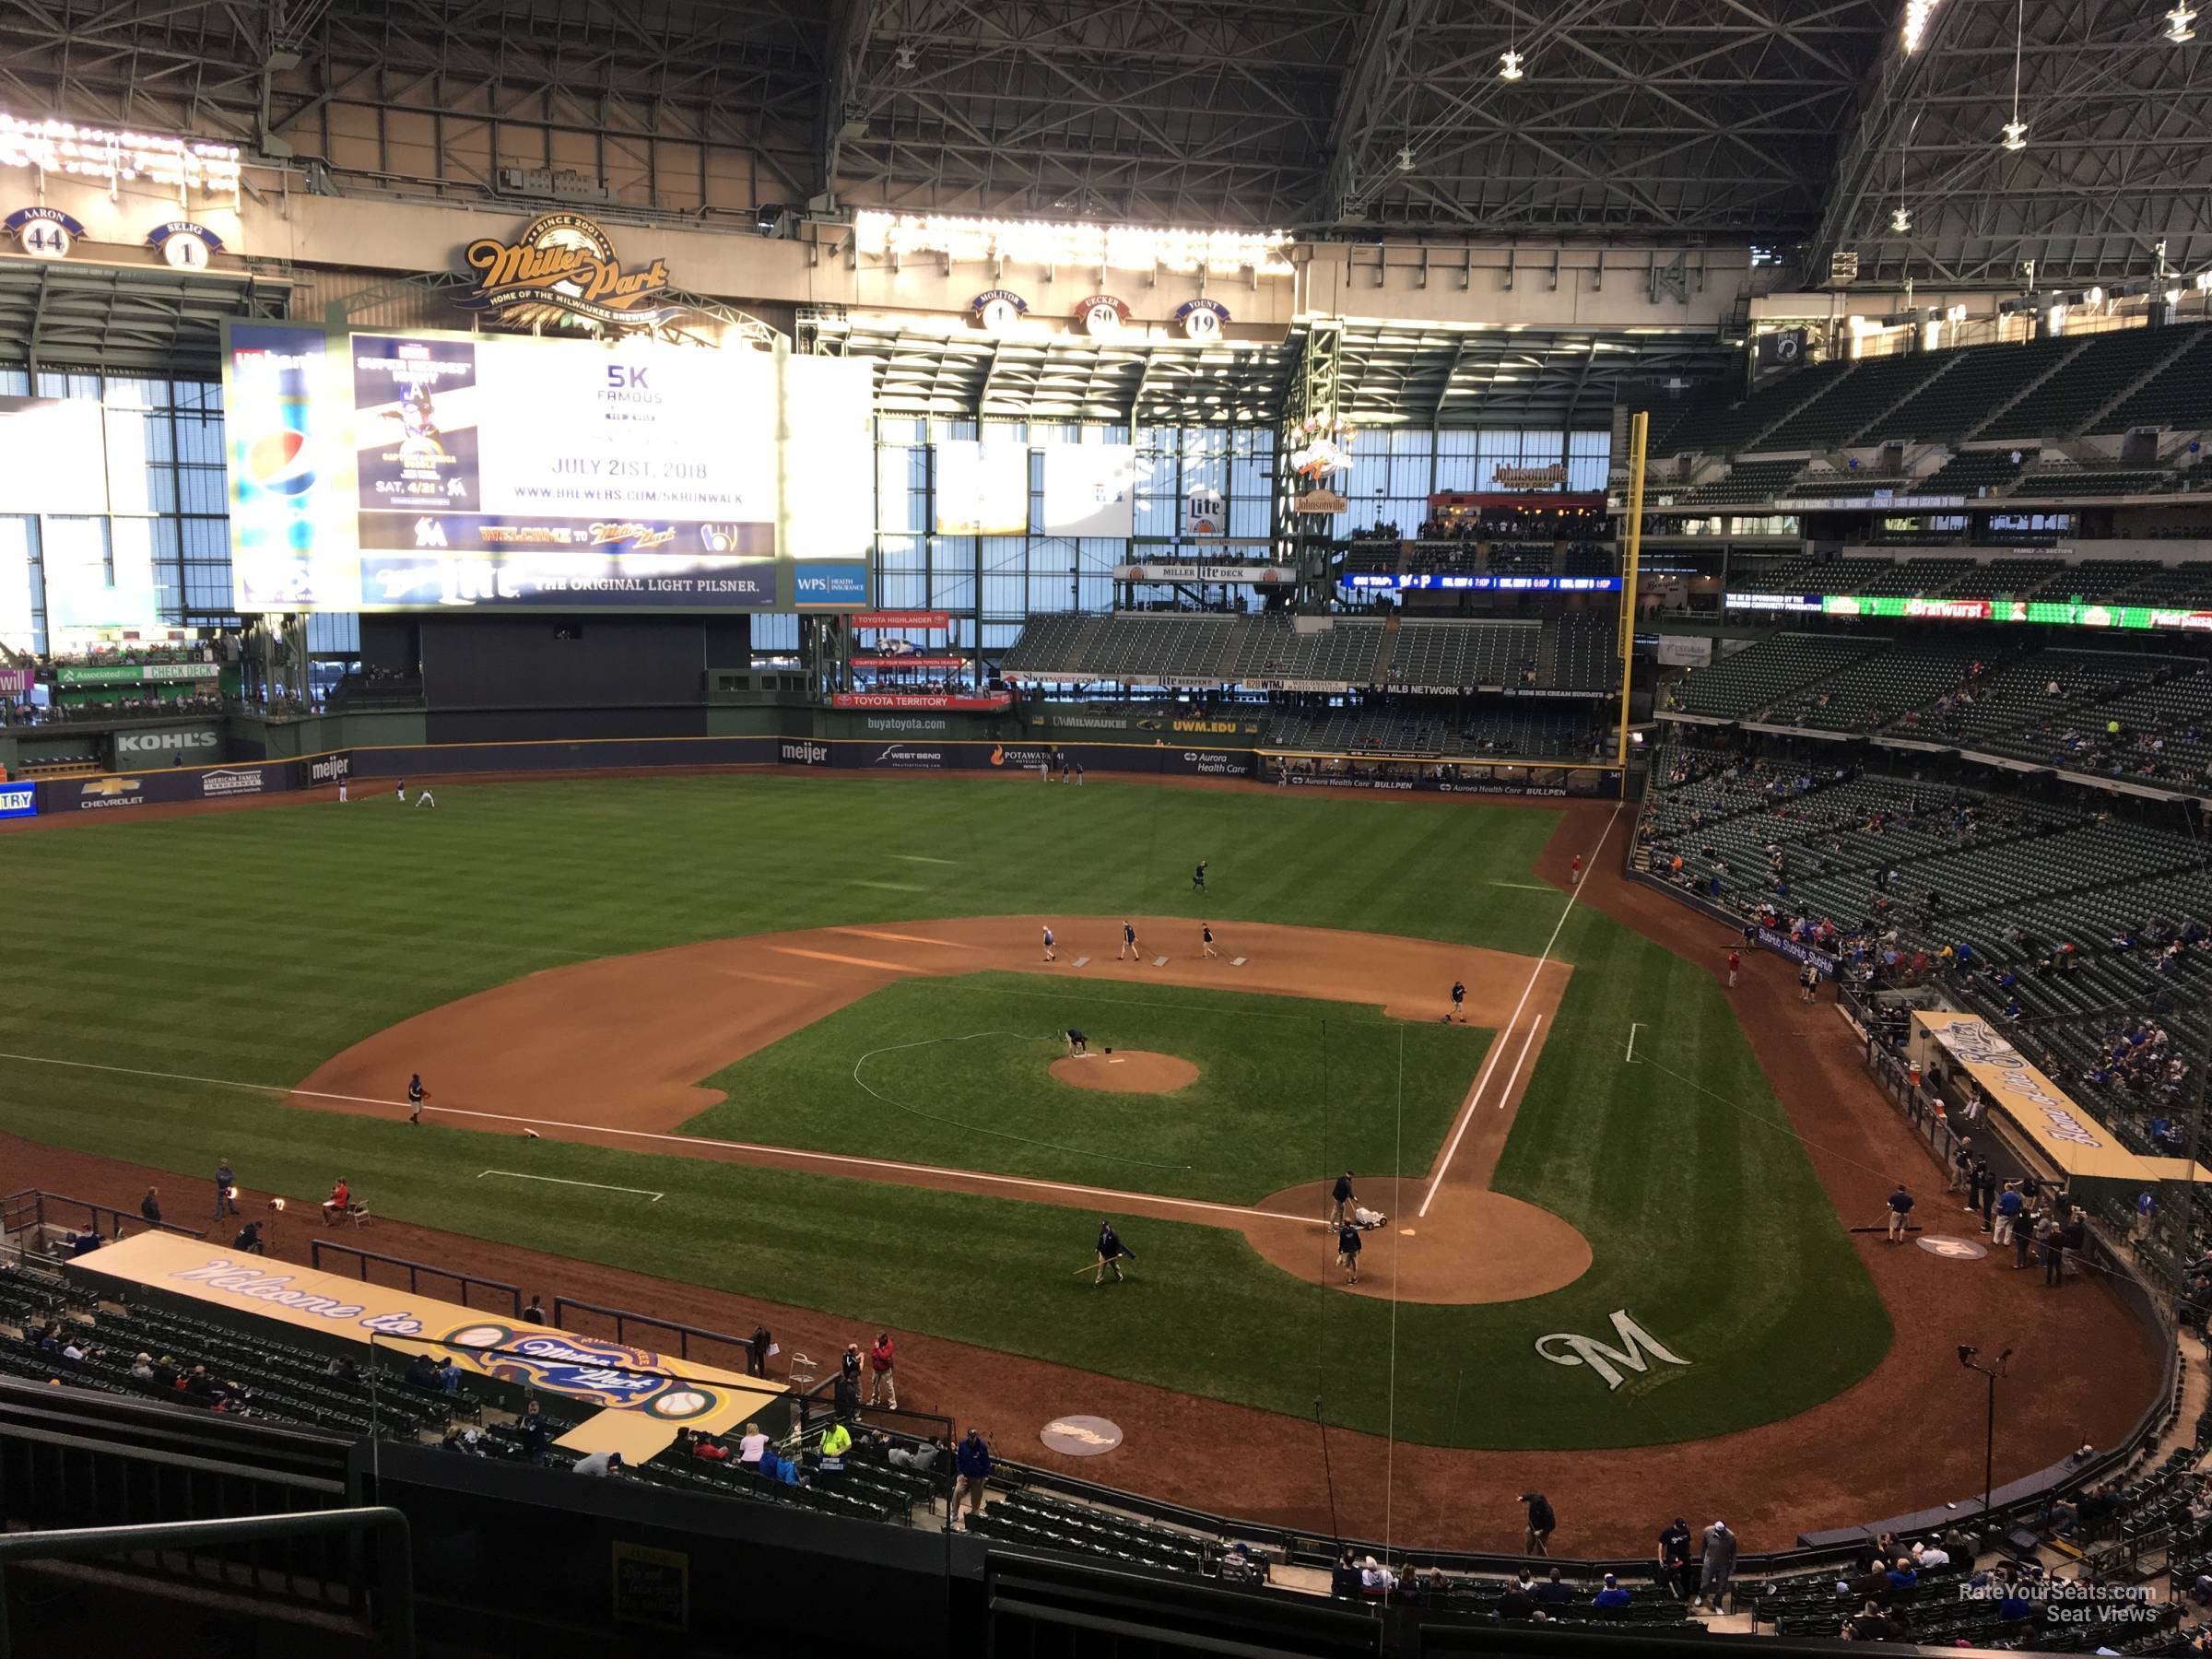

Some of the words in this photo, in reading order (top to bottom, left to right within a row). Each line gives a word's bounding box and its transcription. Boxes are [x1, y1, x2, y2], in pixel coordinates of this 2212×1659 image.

[24, 208, 65, 222] AARON
[167, 223, 203, 235] SELIG
[536, 217, 571, 233] SINCE
[574, 218, 599, 238] 2001
[28, 229, 64, 252] 44
[181, 243, 194, 265] 1
[467, 241, 593, 288] Miller
[570, 258, 667, 302] Park
[980, 291, 1019, 305] MOLITOR
[1085, 295, 1119, 307] UECKER
[1188, 300, 1218, 310] YOUNT
[489, 291, 517, 306] HOME
[519, 289, 532, 299] OF
[535, 290, 553, 300] THE
[556, 294, 611, 319] MILWAUKEE
[613, 311, 658, 322] BREWERS
[1093, 308, 1112, 321] 50
[1192, 315, 1215, 332] 19
[607, 364, 649, 389] 5K
[597, 390, 663, 404] FAMOUS
[551, 459, 600, 475] JULY
[664, 462, 707, 479] 2018
[1491, 463, 1567, 482] Johnsonville
[406, 481, 436, 494] 4/21
[1191, 499, 1219, 518] Lite
[1297, 499, 1345, 511] Johnsonville
[573, 531, 588, 542] TO
[534, 578, 567, 592] THE
[570, 578, 644, 592] ORIGINAL
[648, 580, 693, 593] LIGHT
[697, 580, 759, 593] PILSNER.
[797, 578, 826, 590] WPS
[1910, 599, 1983, 618] Bratwurst
[2182, 610, 2212, 629] Sausa
[151, 667, 184, 677] CHECK
[187, 665, 212, 676] DECK
[1246, 680, 1260, 688] 620
[1261, 680, 1284, 689] WTMJ
[1387, 685, 1408, 693] MLB
[1411, 685, 1459, 695] NETWORK
[853, 696, 893, 706] TOYOTA
[896, 697, 947, 706] TERRITORY
[867, 717, 946, 731] buyatoyota.com
[1173, 721, 1236, 733] UWM.EDU
[118, 732, 218, 752] KOHL'S
[782, 742, 827, 764] meijer
[1199, 754, 1227, 762] Aurora
[312, 755, 349, 780] meijer
[1198, 763, 1225, 772] Health
[1227, 764, 1245, 773] Care
[1374, 782, 1413, 790] BULLPEN
[1453, 783, 1477, 792] Aurora
[1479, 785, 1503, 794] Health
[1526, 788, 1566, 796] BULLPEN
[81, 796, 144, 808] CHEVROLET
[1759, 928, 1781, 947] StubHub
[1783, 939, 1806, 959] StubHub
[1808, 951, 1833, 973] StubHub
[171, 1259, 366, 1319] Welcome
[359, 1312, 423, 1335] to
[524, 1341, 611, 1368] Miller
[1535, 1309, 1694, 1391] M
[570, 1368, 655, 1389] Park
